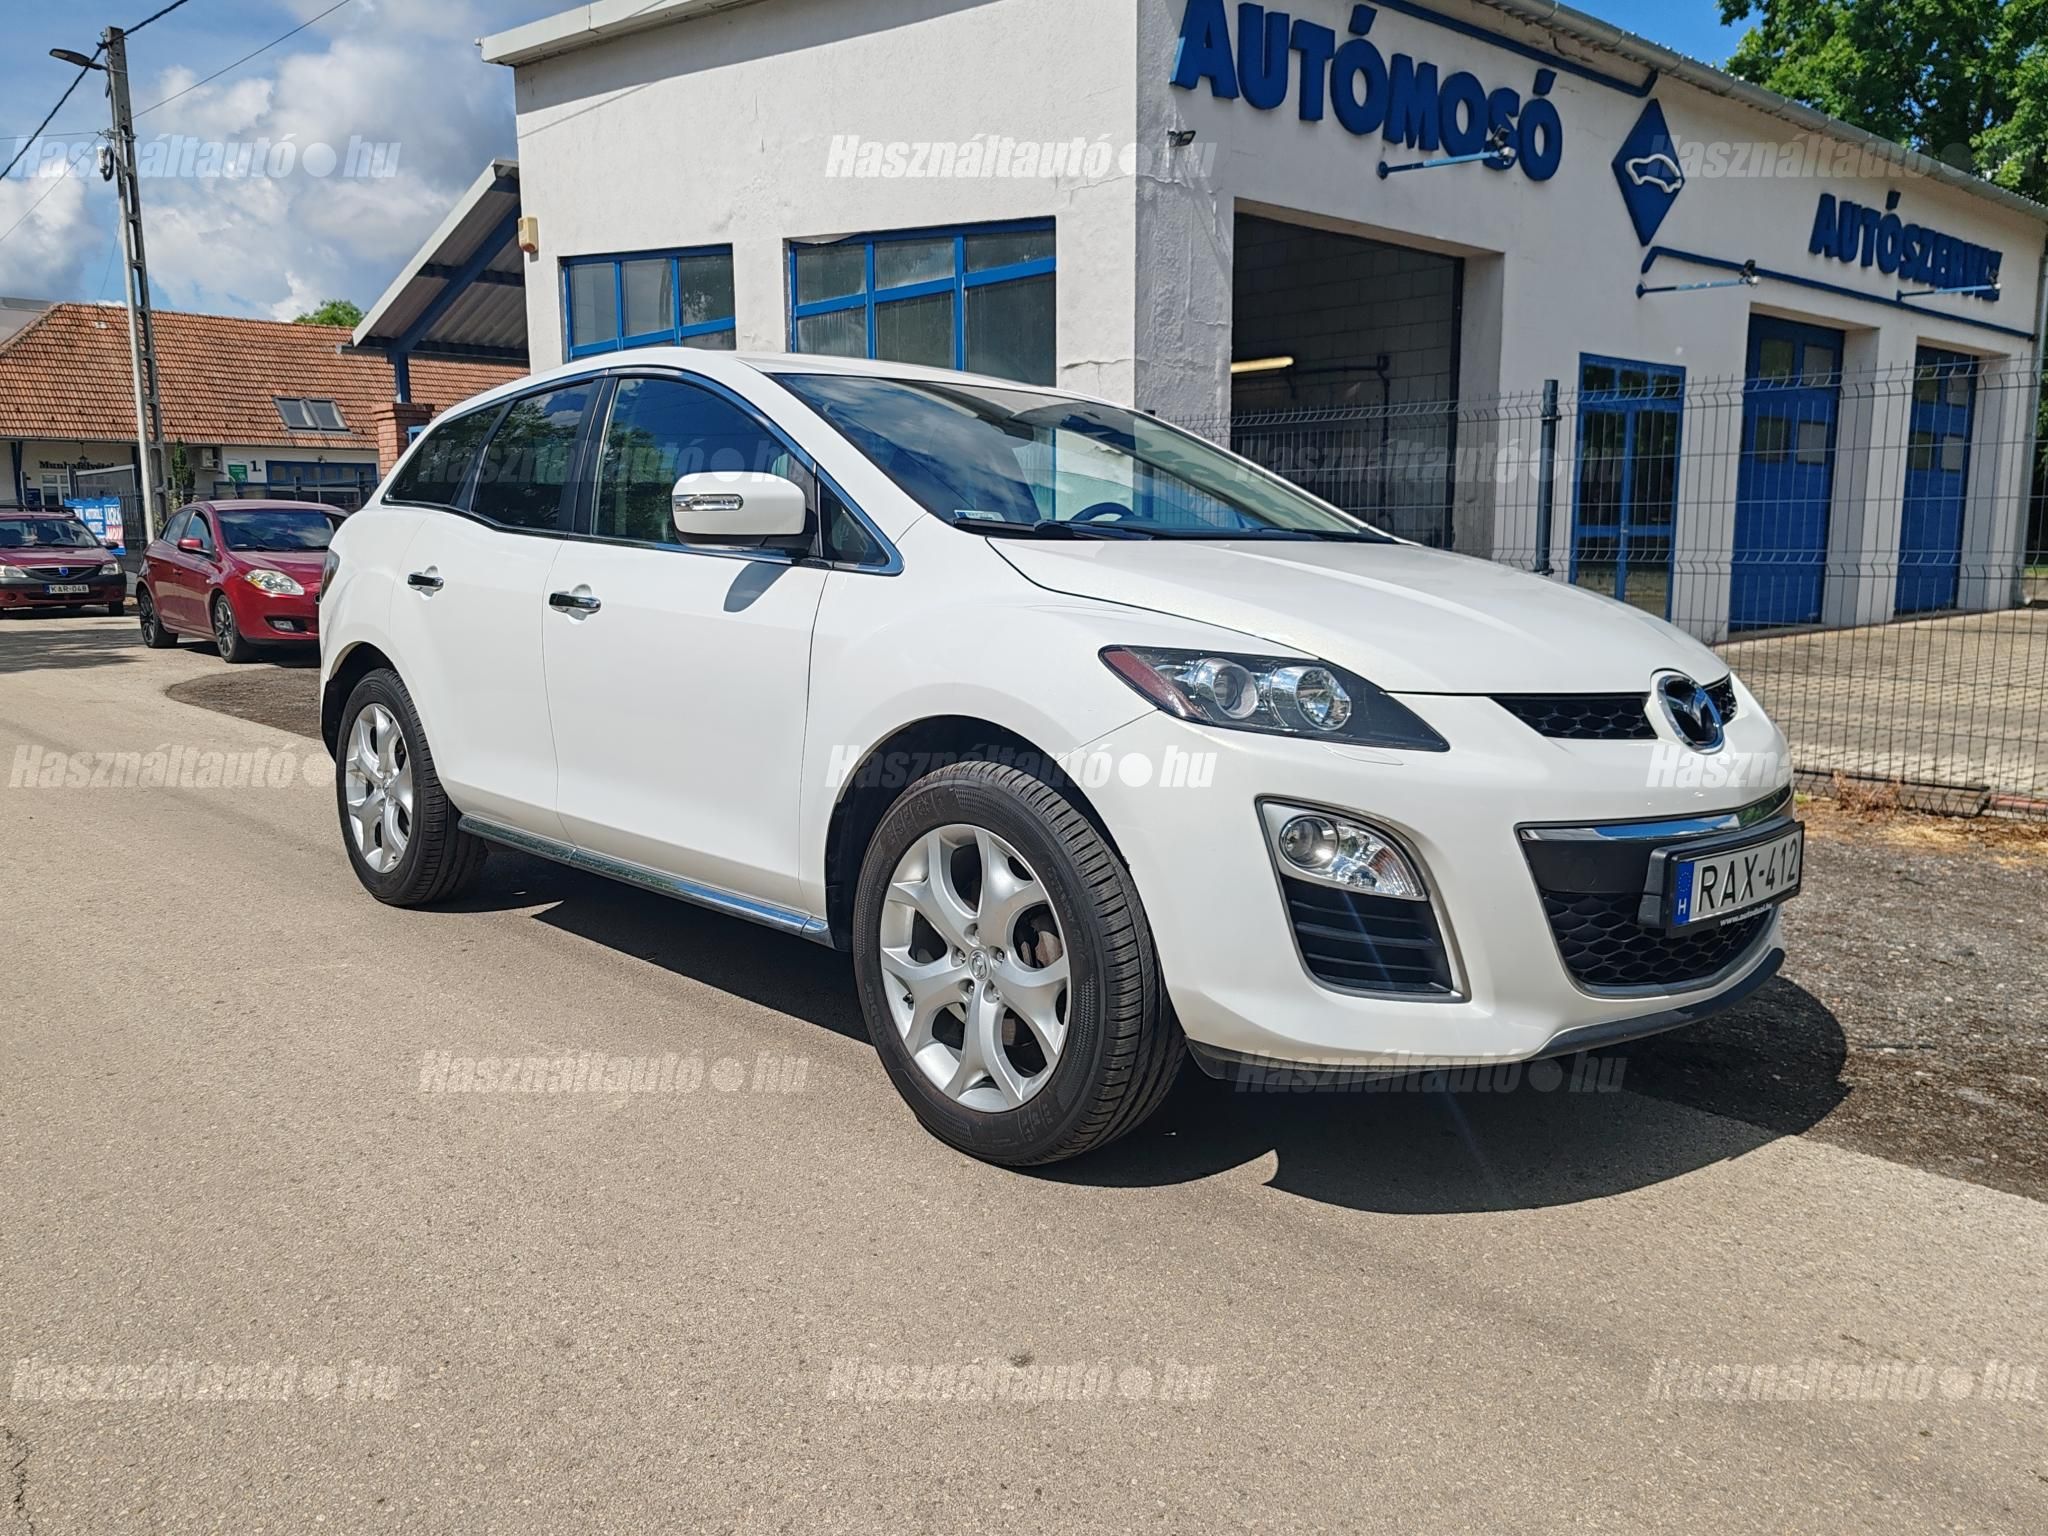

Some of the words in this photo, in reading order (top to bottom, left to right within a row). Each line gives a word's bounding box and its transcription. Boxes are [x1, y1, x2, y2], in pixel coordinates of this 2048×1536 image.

[1169, 0, 1563, 181] AUTÓMOSÓ
[250, 460, 262, 472] 1.
[1696, 838, 1798, 912] RAX-412
